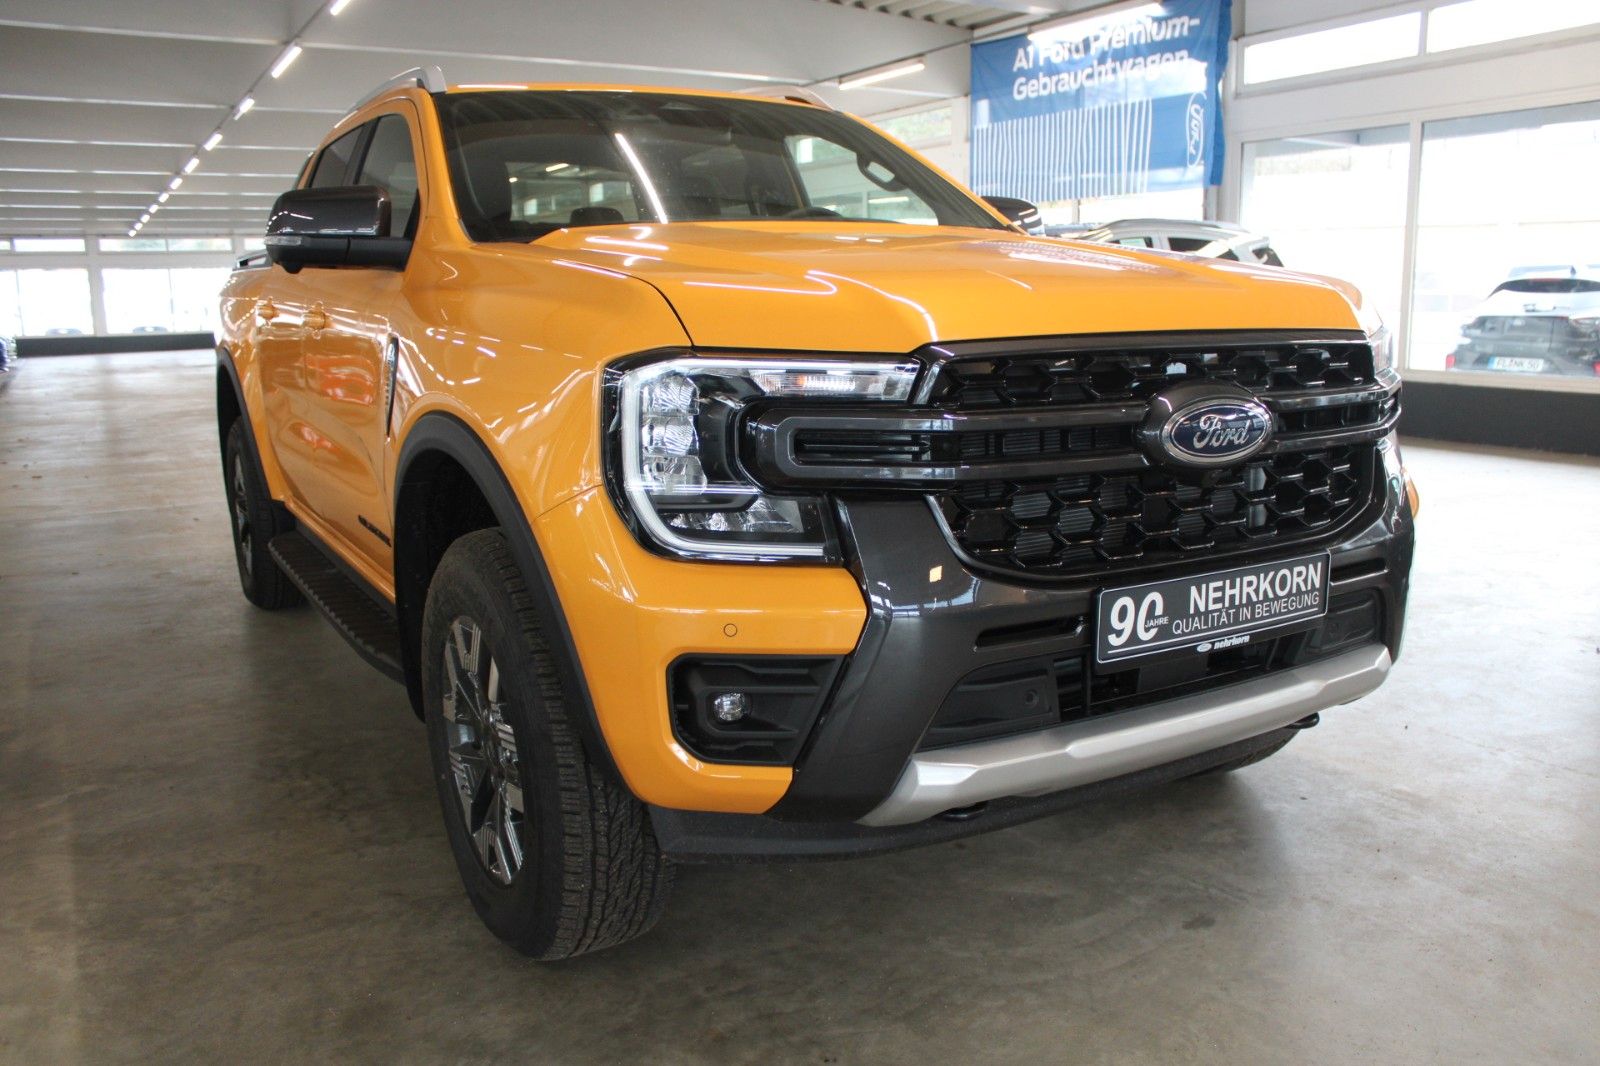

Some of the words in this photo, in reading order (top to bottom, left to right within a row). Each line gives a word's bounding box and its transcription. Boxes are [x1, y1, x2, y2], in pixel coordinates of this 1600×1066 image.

[1089, 15, 1200, 58] Premium-
[1012, 49, 1189, 100] Gebrauchtwagen
[1193, 414, 1251, 449] Ford
[1189, 562, 1322, 614] NEHRKORN
[1107, 591, 1164, 647] 90
[1144, 616, 1169, 629] JAHRE
[1172, 608, 1235, 636] QUALITÄT
[1239, 606, 1251, 622] IN
[1255, 591, 1320, 617] BEWEGUNG
[1213, 634, 1250, 651] nehrkorn
